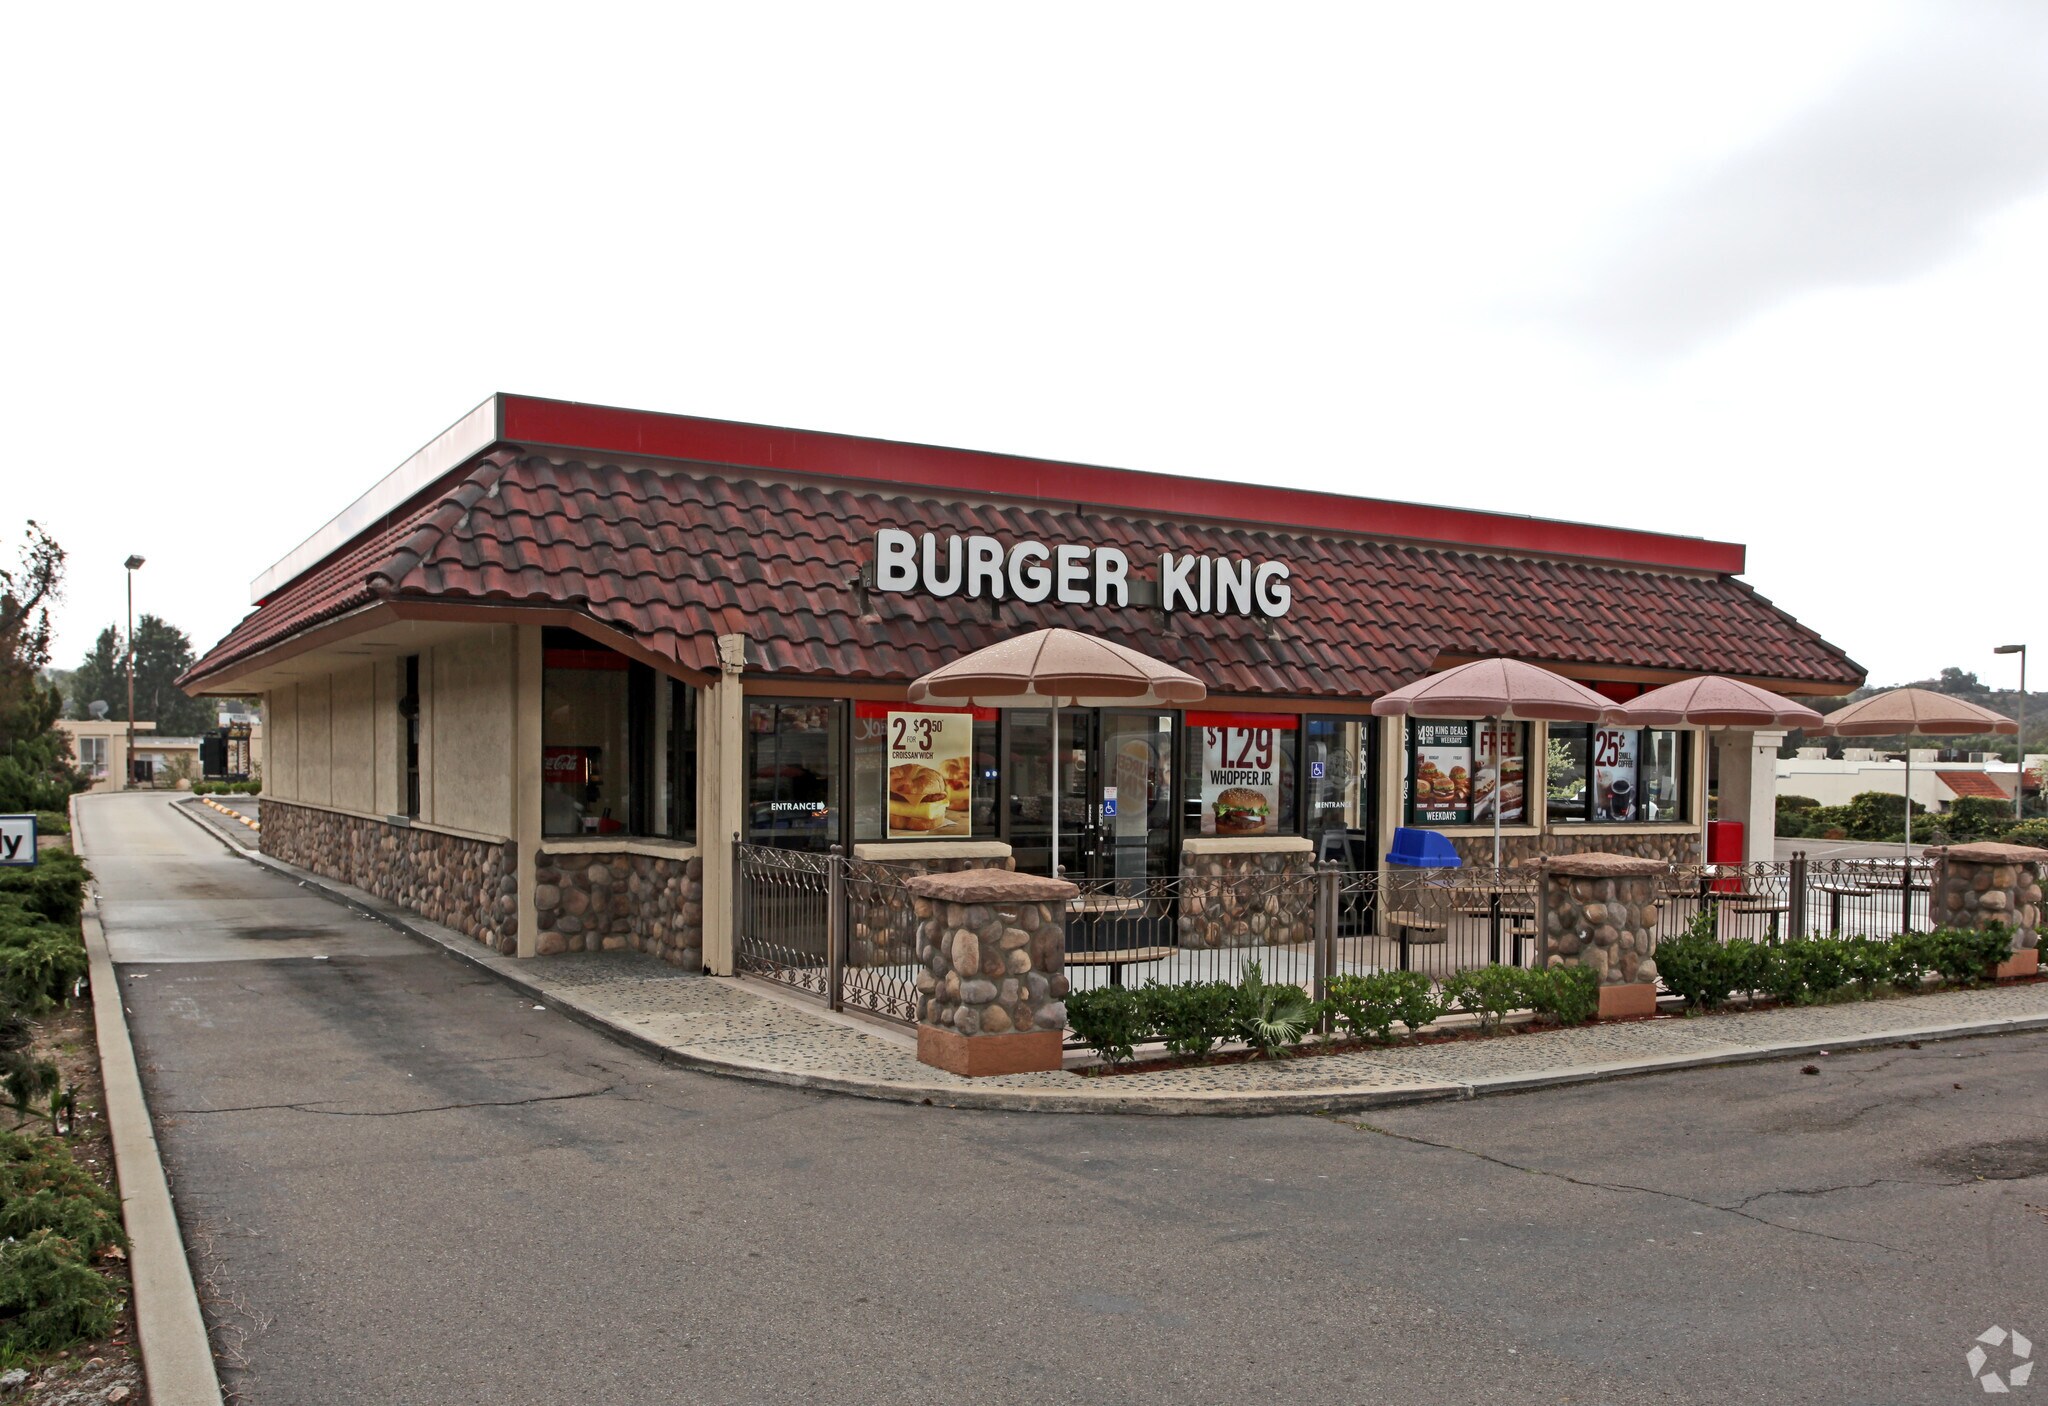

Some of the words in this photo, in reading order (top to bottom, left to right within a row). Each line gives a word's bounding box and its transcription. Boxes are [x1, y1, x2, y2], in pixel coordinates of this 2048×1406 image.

[875, 528, 1129, 608] BURGER
[1160, 552, 1291, 618] KING
[892, 717, 907, 751] 2
[906, 735, 917, 743] FOR
[1435, 725, 1449, 735] KING
[1449, 726, 1468, 736] DEALS
[1440, 736, 1462, 744] WEEKDAYS
[1480, 731, 1516, 756] FREE
[1206, 726, 1273, 770] $1.29
[1618, 751, 1632, 760] SMALL
[1617, 760, 1634, 768] COFFEE
[1210, 770, 1259, 785] WHOPPER
[1260, 771, 1273, 786] JR.
[771, 802, 816, 811] ENTRANCE
[1321, 801, 1352, 809] ENTRANCE
[1426, 811, 1456, 820] WEEKDAYS
